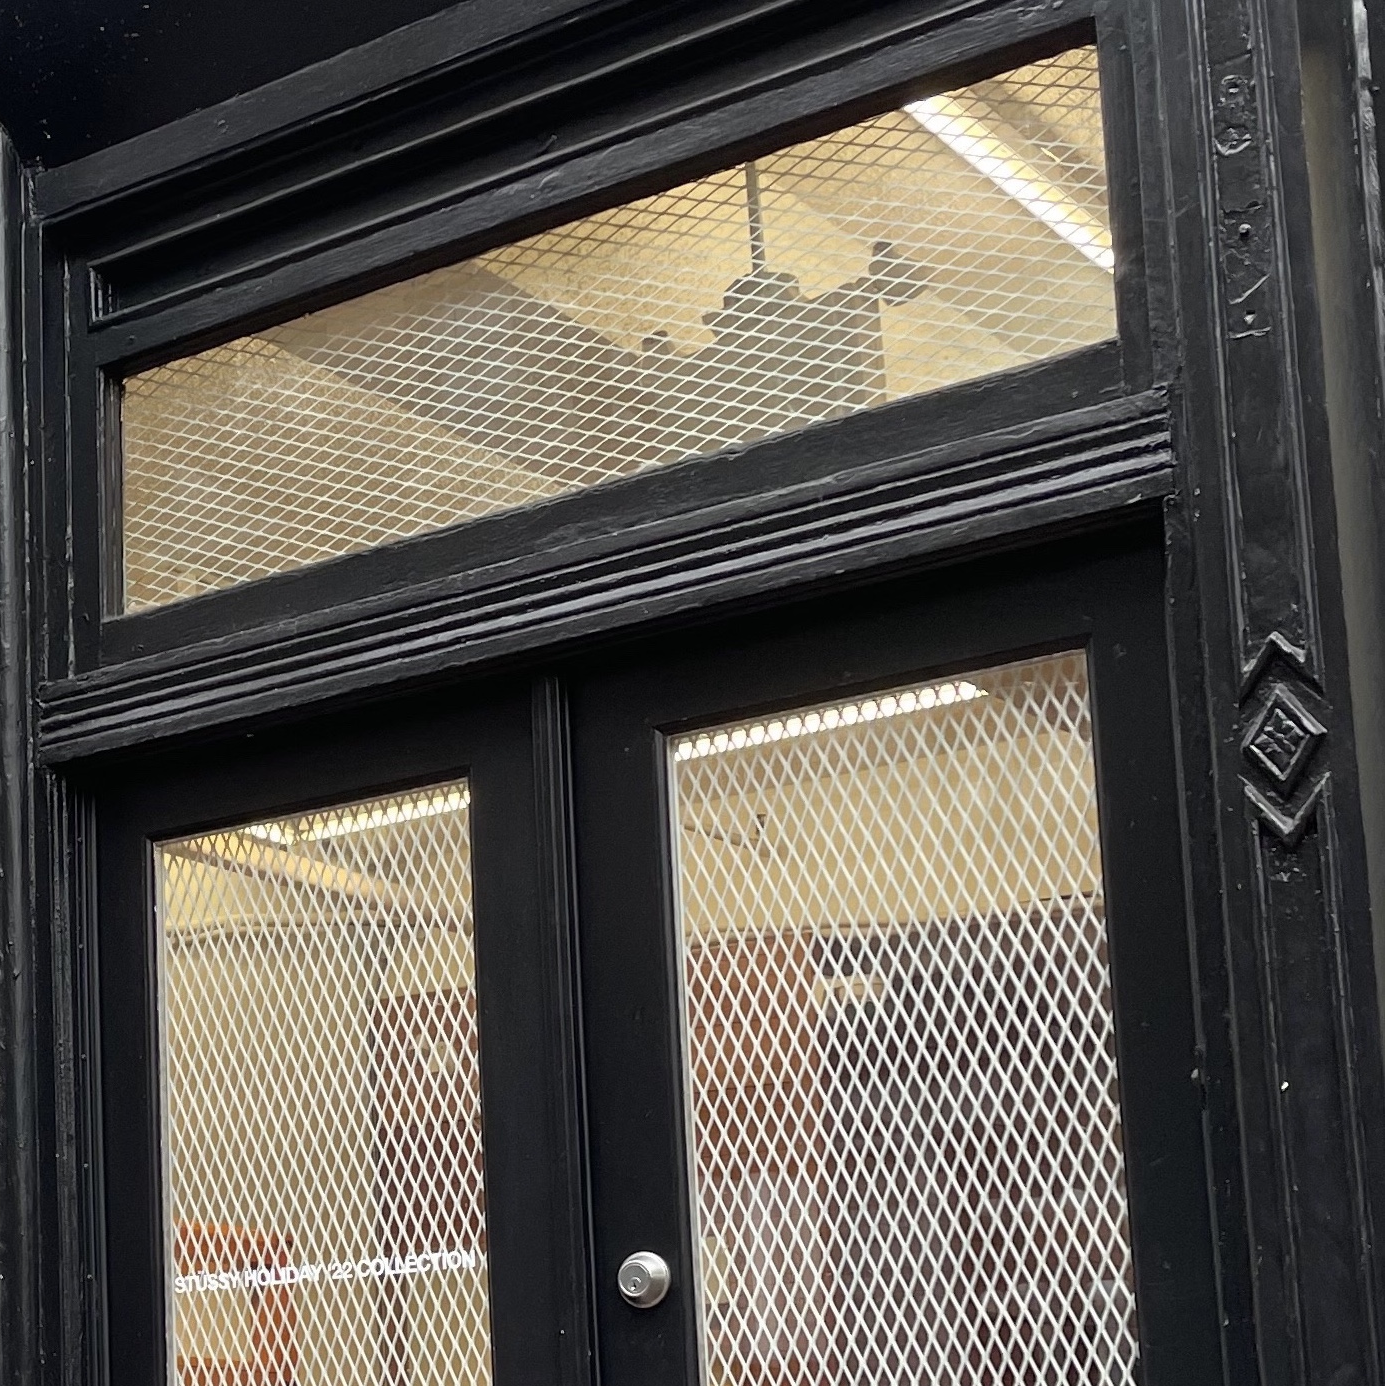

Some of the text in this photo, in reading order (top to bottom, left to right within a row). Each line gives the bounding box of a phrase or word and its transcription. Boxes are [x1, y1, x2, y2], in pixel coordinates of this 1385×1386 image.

[175, 1269, 240, 1294] STÜSSY
[244, 1264, 324, 1288] HOLIDAY
[357, 1249, 476, 1278] COLLECTION
